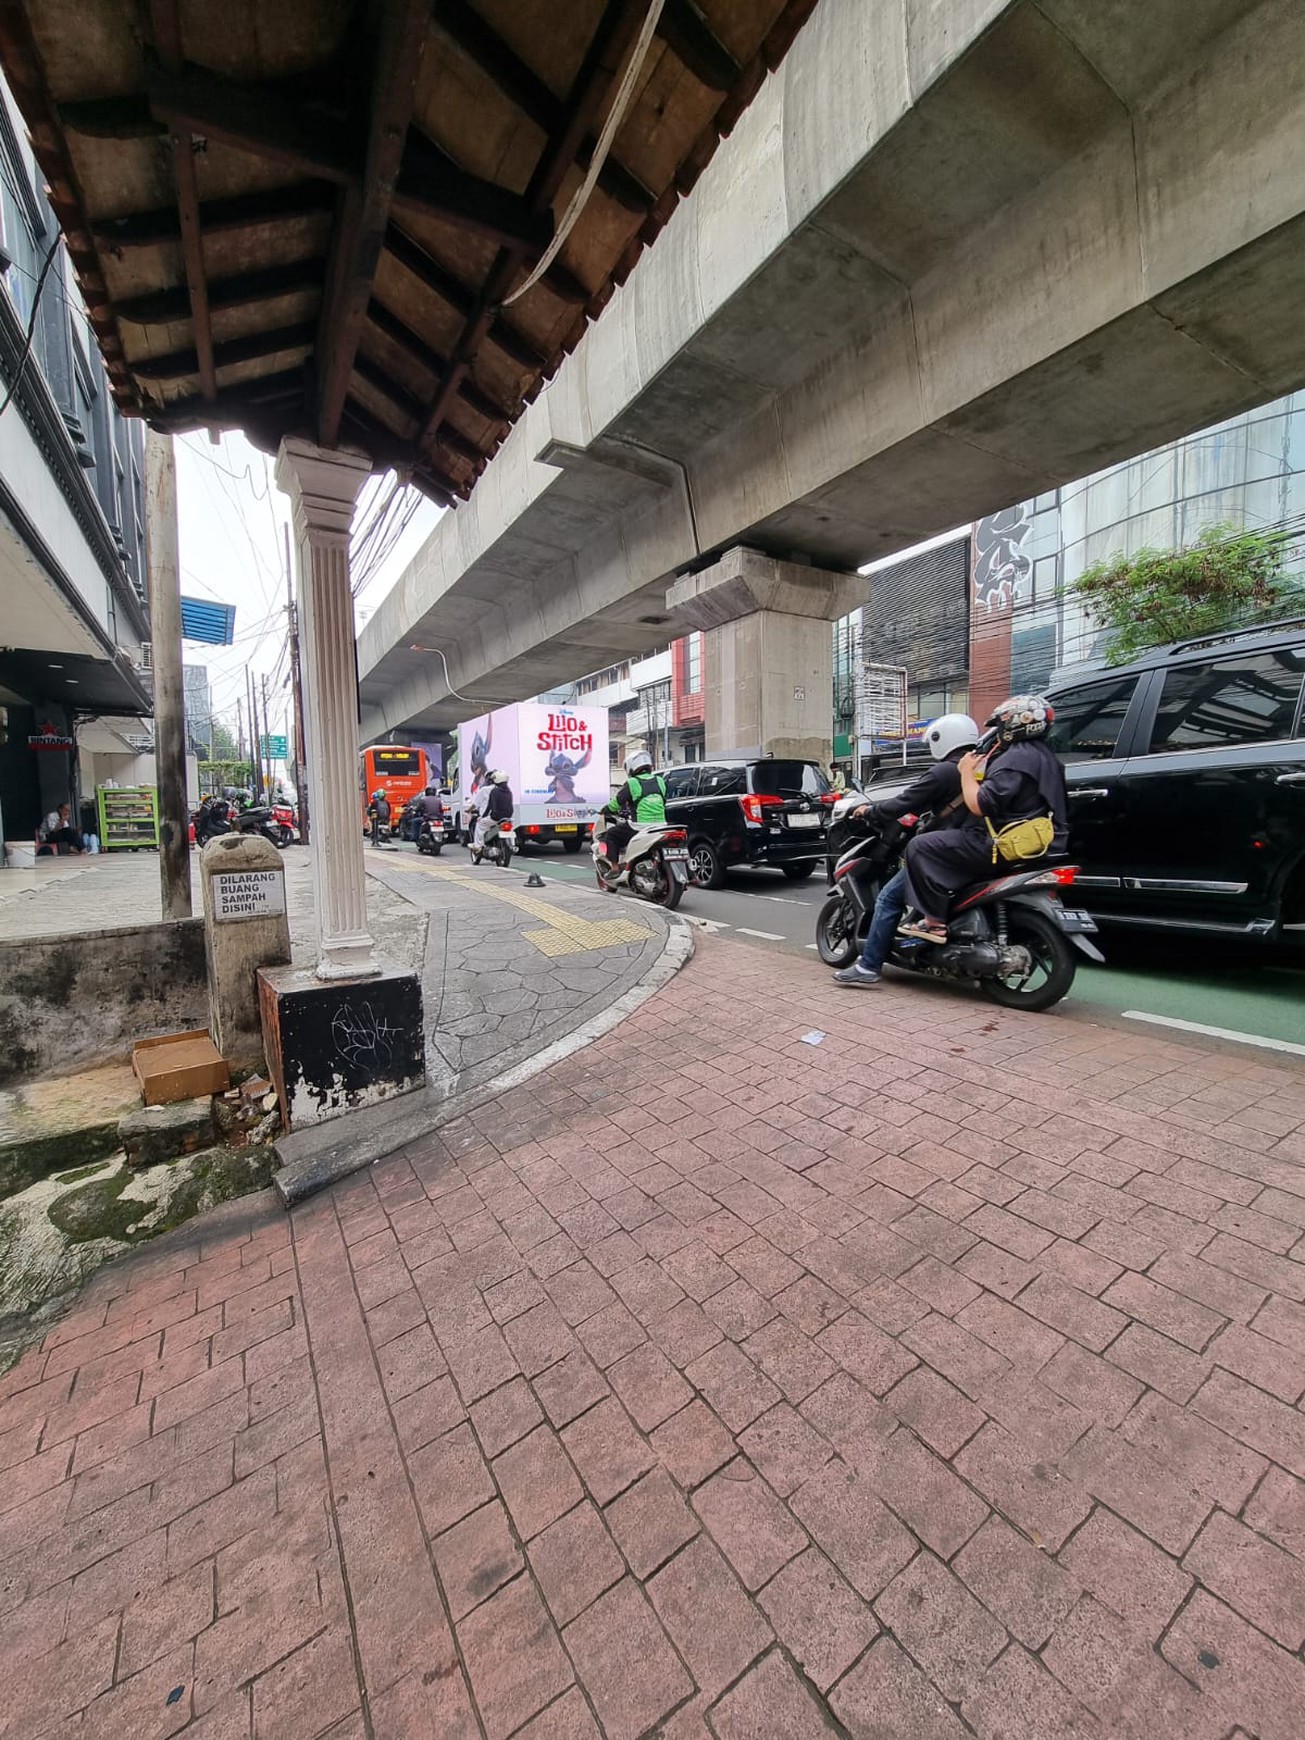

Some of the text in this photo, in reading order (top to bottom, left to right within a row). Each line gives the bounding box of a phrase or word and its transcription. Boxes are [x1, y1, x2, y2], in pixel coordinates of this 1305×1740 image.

[579, 720, 588, 731] &
[220, 873, 275, 884] DILARANG
[221, 884, 259, 894] BUANG
[222, 893, 266, 904] SAMPAH
[222, 903, 256, 914] DISINI
